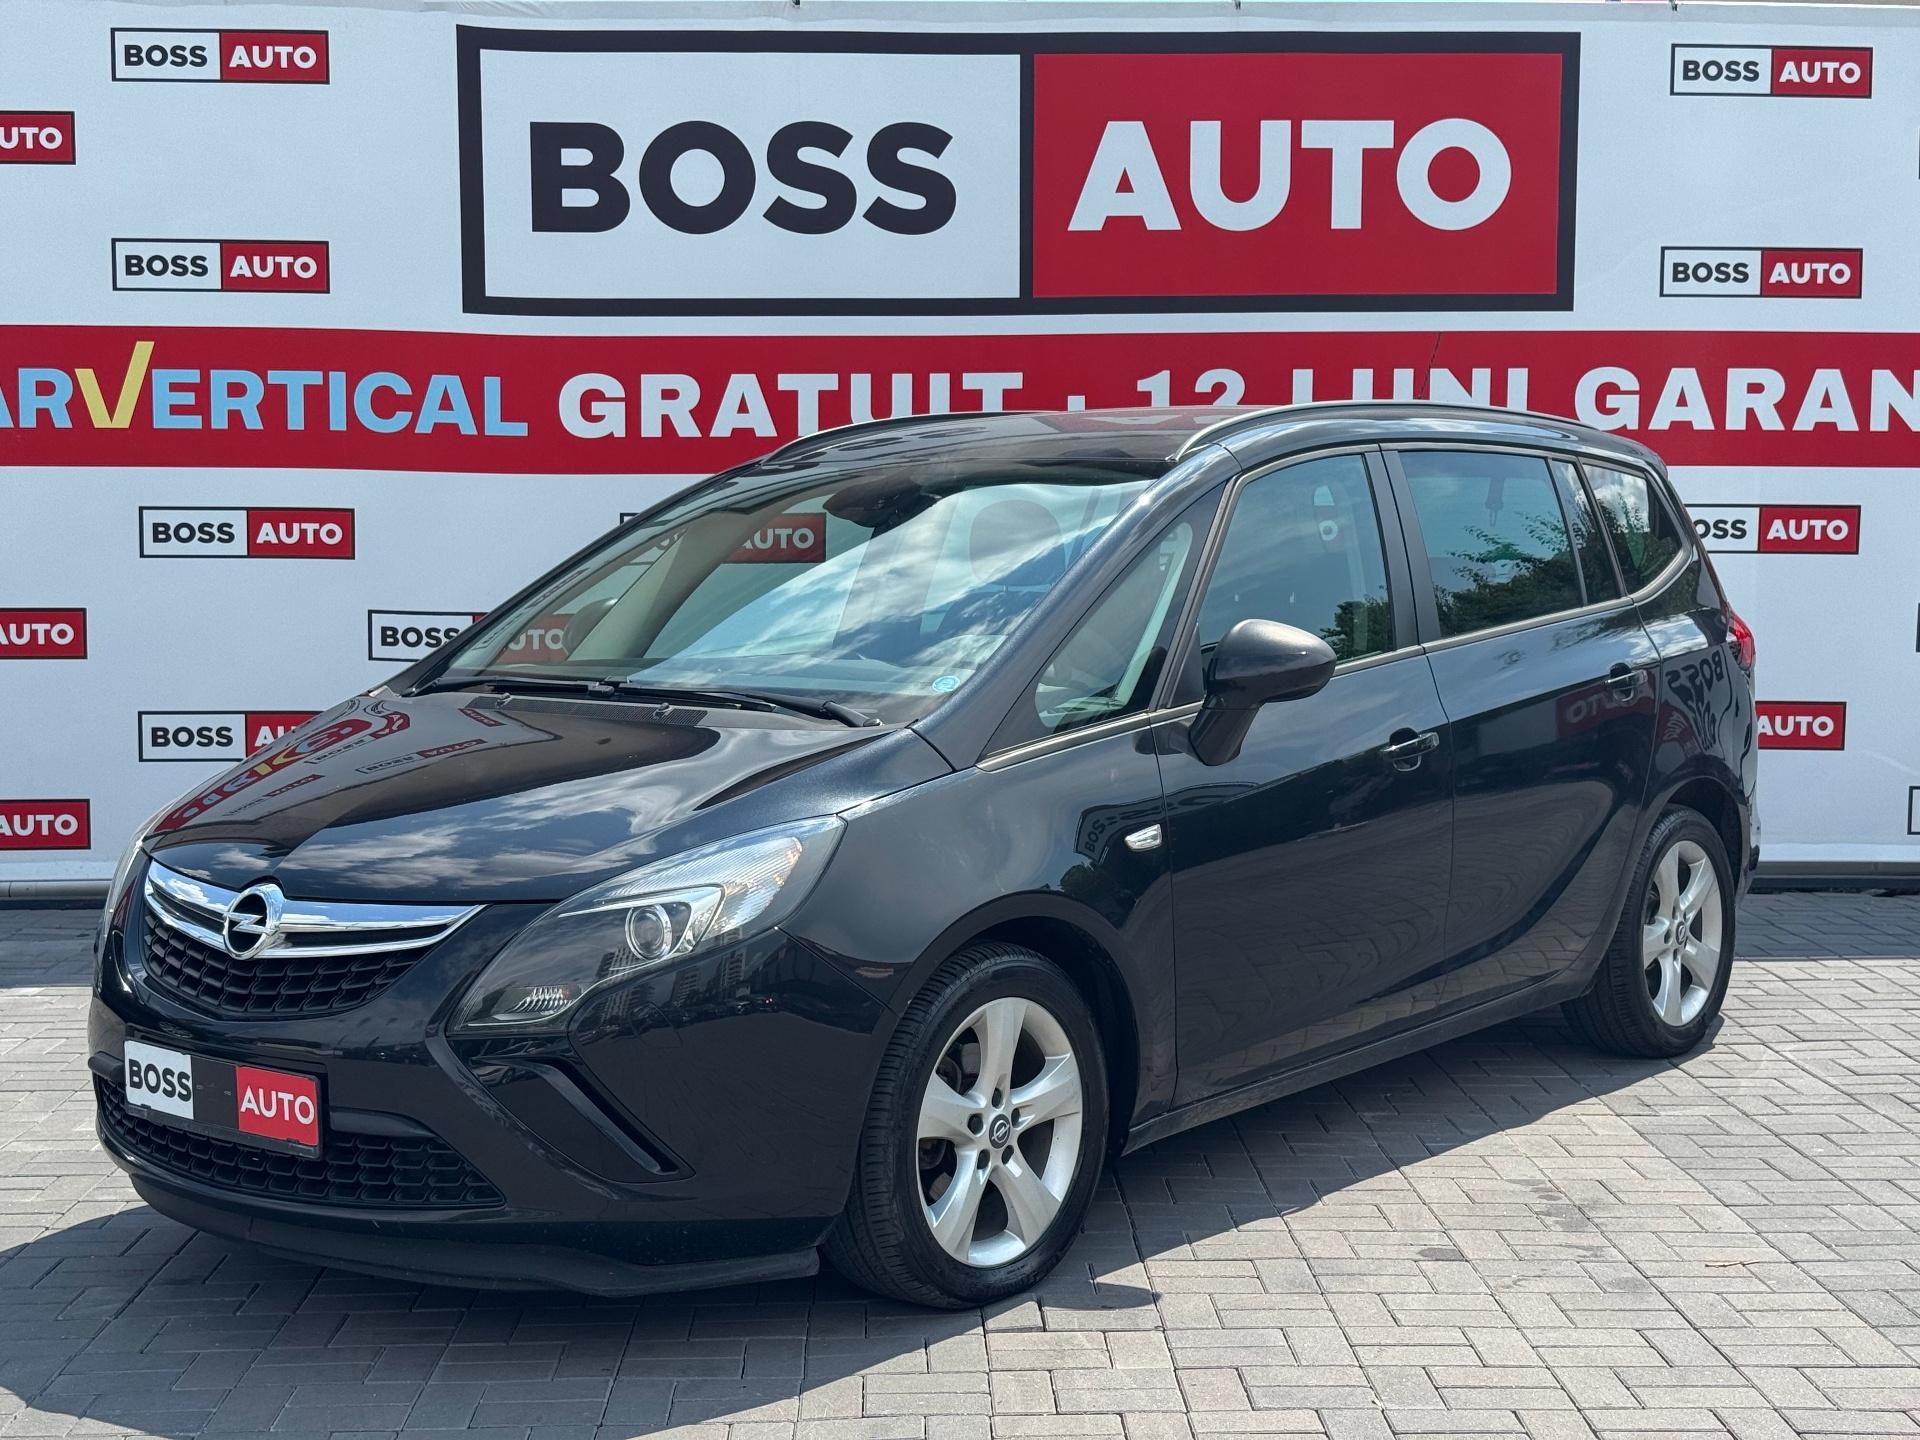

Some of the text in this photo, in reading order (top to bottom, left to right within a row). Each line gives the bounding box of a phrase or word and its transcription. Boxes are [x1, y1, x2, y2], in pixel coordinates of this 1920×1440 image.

[124, 44, 317, 69] BOSS AUTO
[1682, 60, 1862, 84] BOSS AUTO
[530, 117, 1512, 236] BOSS AUTO
[124, 254, 318, 279] BOSS AUTO
[1672, 262, 1851, 285] BOSS AUTO
[558, 372, 1024, 438] GRATUIT
[1137, 368, 1246, 407] 12
[1574, 366, 1920, 432] GARAN
[152, 522, 343, 545] BOSS AUTO
[1693, 518, 1849, 541] OSS AUTO
[508, 628, 565, 650] UTO
[151, 726, 234, 748] BOSS
[1757, 715, 1835, 737] AUTO
[0, 813, 79, 836] AUTO
[128, 1058, 315, 1125] BOSS AUTO
